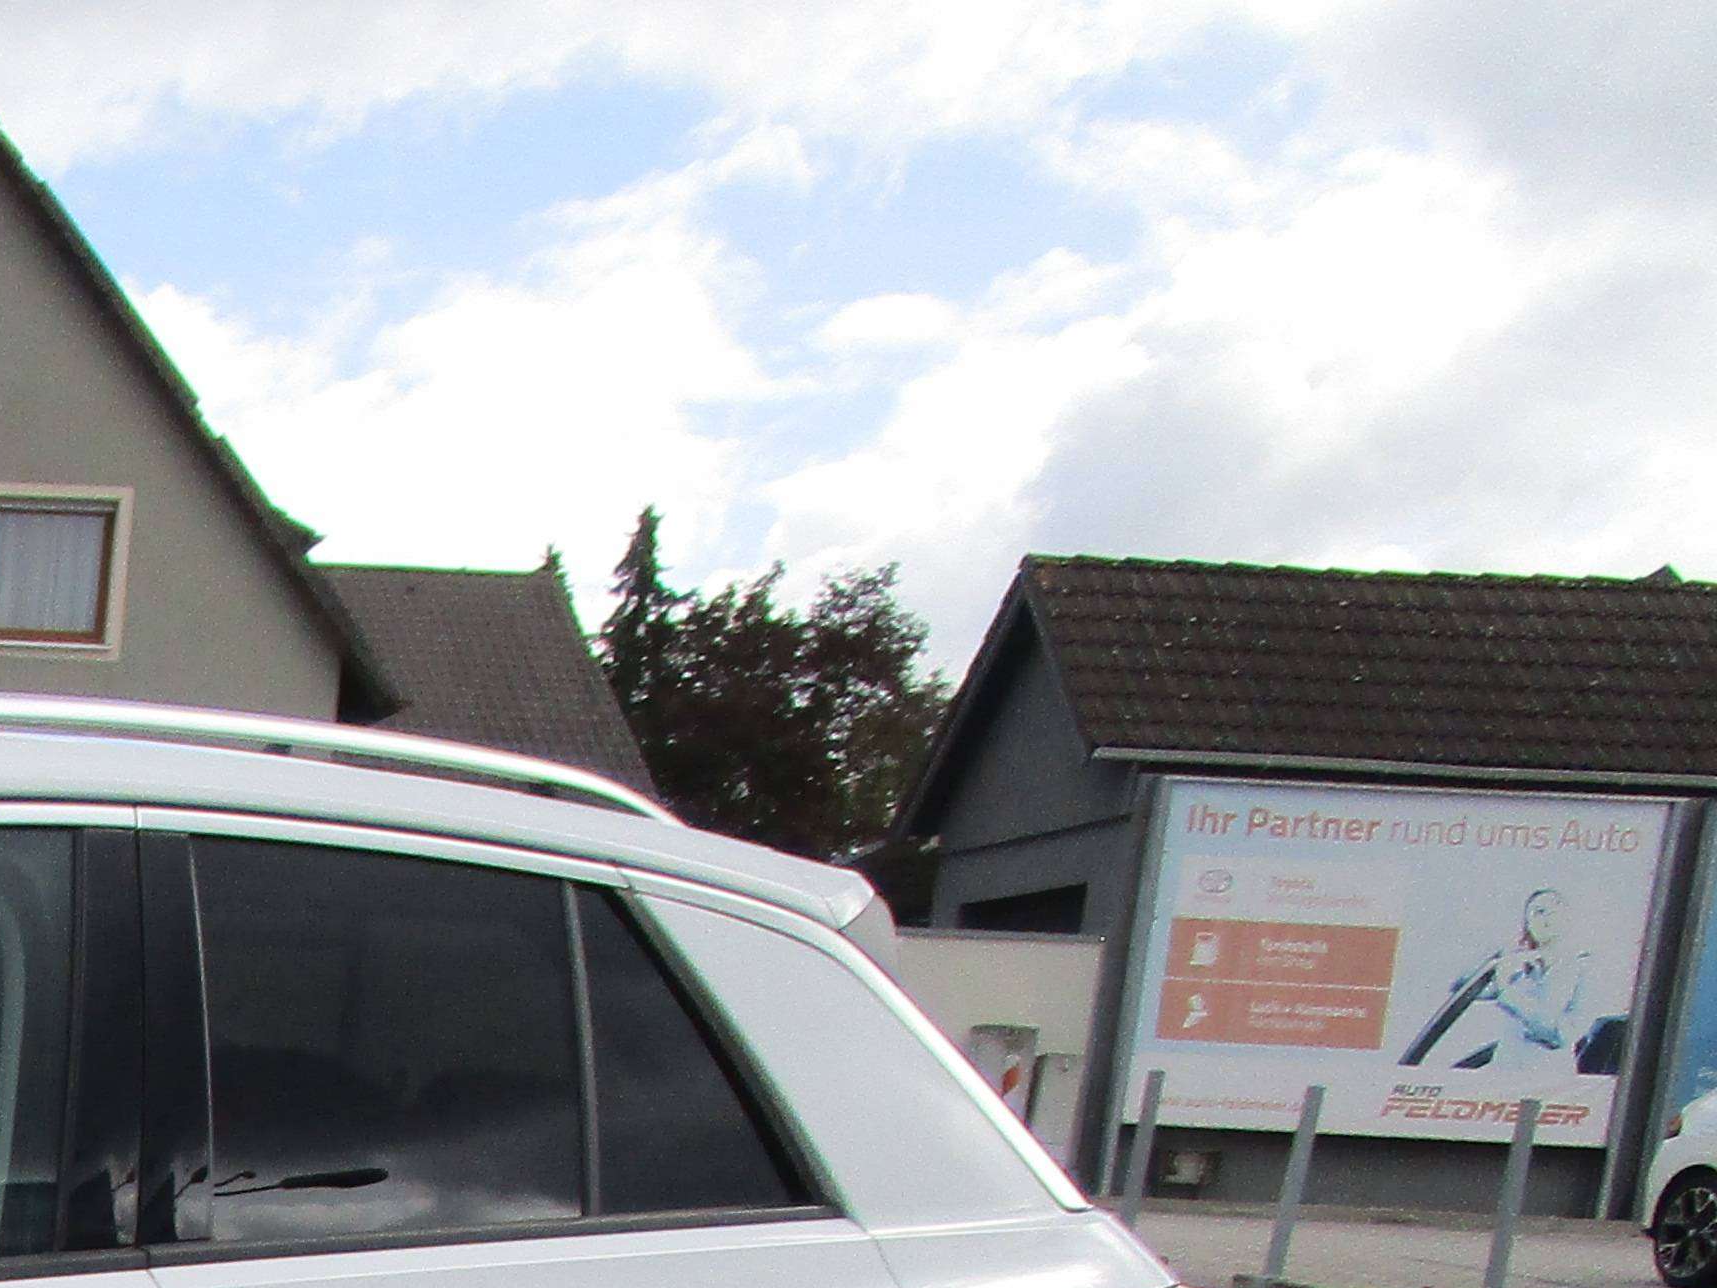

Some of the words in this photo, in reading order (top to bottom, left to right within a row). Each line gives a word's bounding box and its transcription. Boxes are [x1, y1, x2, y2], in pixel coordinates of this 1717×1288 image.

[1185, 803, 1237, 835] Ihr
[1245, 807, 1382, 843] Partner
[1388, 815, 1468, 847] rund
[1476, 821, 1551, 851] ums
[1558, 819, 1641, 854] Auto
[1392, 1083, 1444, 1098] AUTO
[1381, 1097, 1590, 1127] FELDMEER
